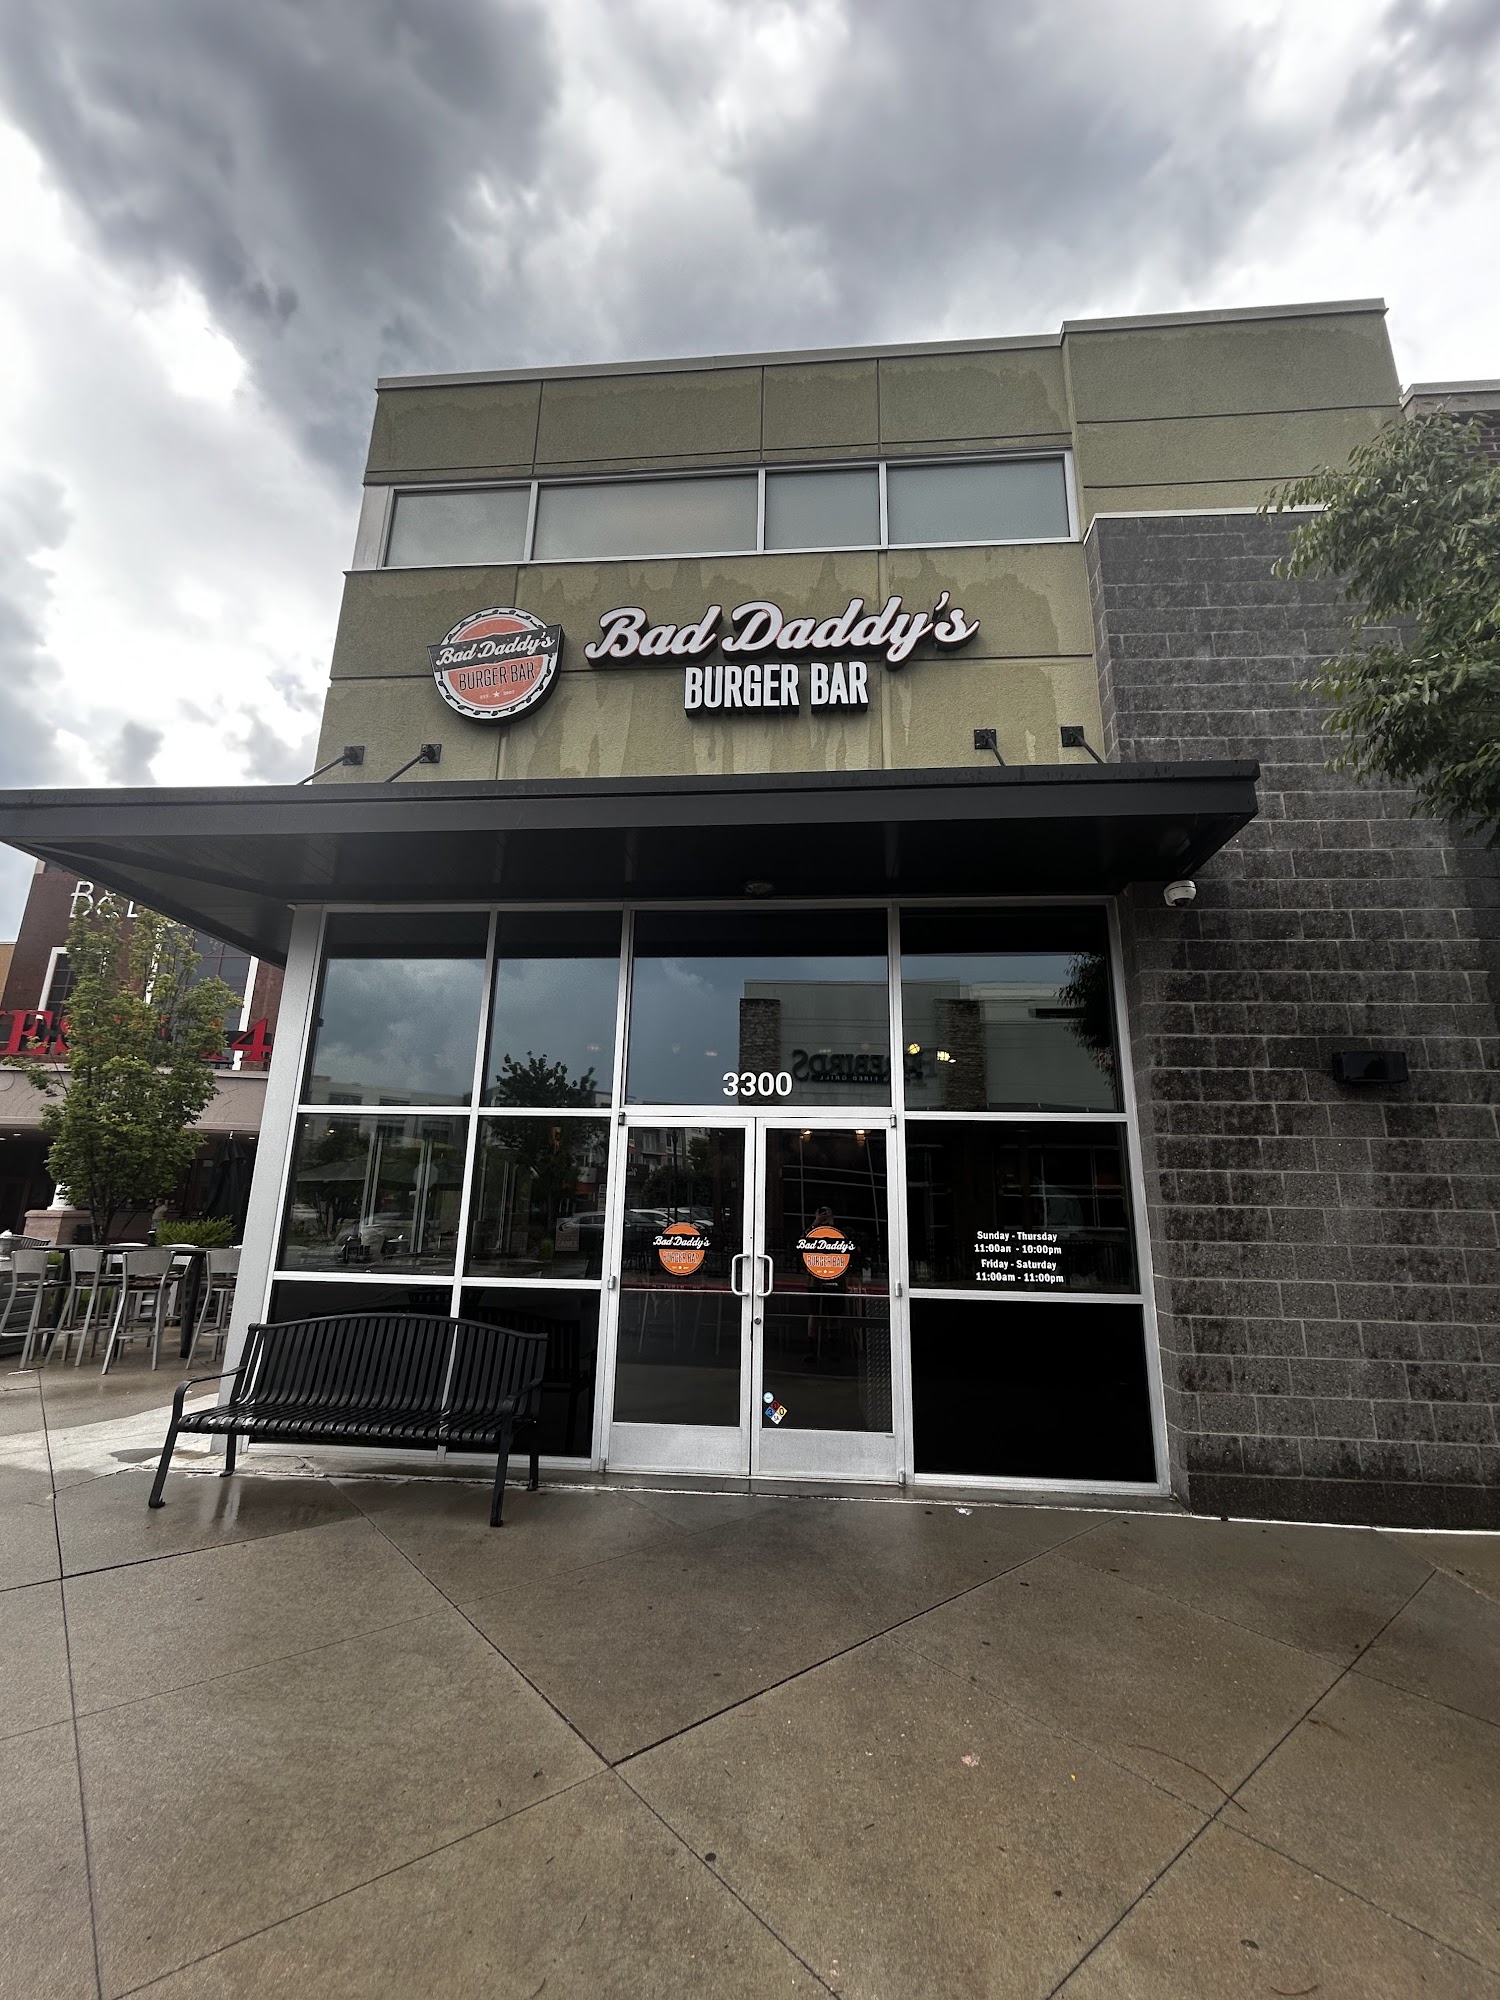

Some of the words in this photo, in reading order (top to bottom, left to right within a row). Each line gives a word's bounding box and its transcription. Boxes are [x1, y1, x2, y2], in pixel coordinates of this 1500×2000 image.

[585, 605, 722, 661] Bad
[722, 591, 980, 668] Daddy's
[436, 643, 477, 665] Bad
[478, 631, 555, 657] Daddy's
[459, 666, 507, 691] BURGER
[510, 662, 535, 683] BAR
[685, 664, 799, 710] BURGER
[810, 662, 868, 707] BAR
[722, 1071, 793, 1097] 3300
[653, 1236, 673, 1246] Bad
[673, 1236, 711, 1249] Daddy's
[976, 1231, 1010, 1241] Sunday
[1016, 1232, 1058, 1242] Thursday
[796, 1239, 818, 1249] Bad
[817, 1240, 856, 1253] Daddy's
[1022, 1245, 1062, 1255] 10:00pm
[981, 1259, 1009, 1270] Friday
[1016, 1260, 1057, 1271] Saturday
[976, 1272, 1016, 1281] 11:00am
[1023, 1273, 1064, 1284] 11:00pm
